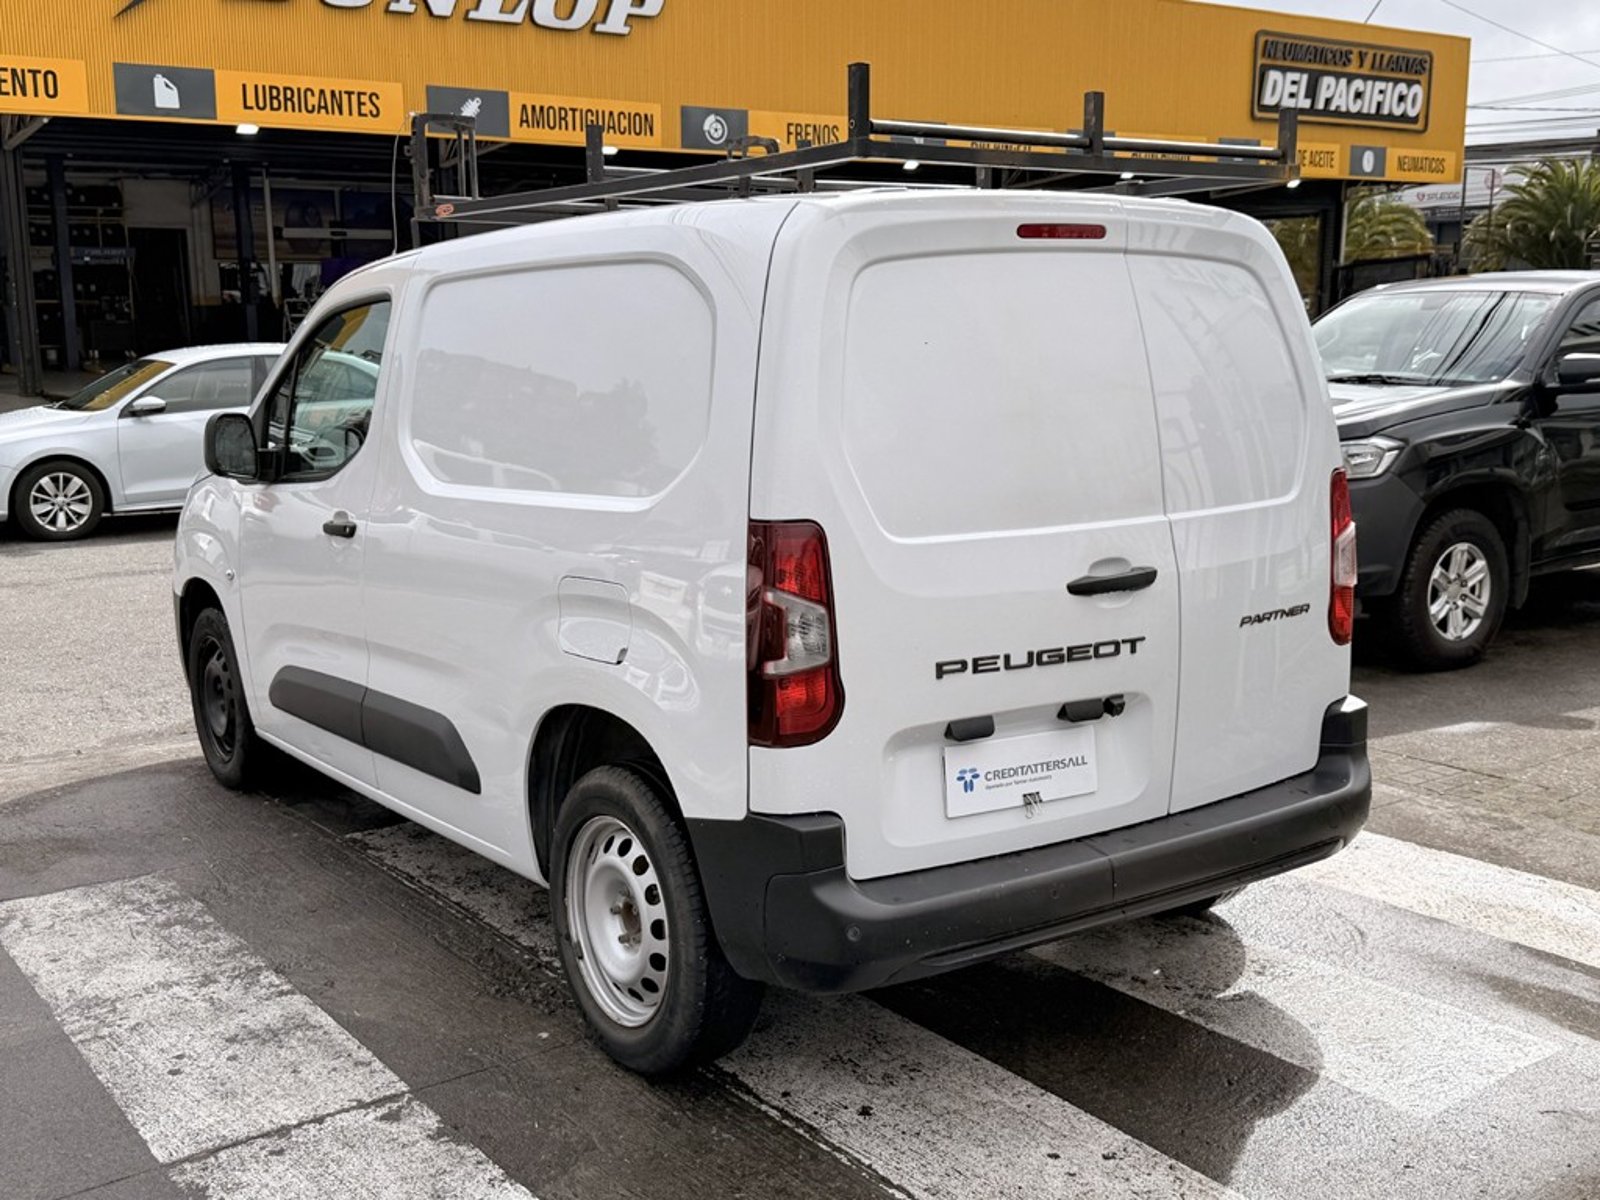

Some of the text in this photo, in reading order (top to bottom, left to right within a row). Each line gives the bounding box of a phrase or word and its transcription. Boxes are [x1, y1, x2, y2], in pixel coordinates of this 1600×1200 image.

[1263, 39, 1428, 75] NEUMATICOS Y LLANTAS
[242, 83, 380, 118] LUBRICANTES
[1261, 69, 1423, 118] DEL PACIFICO
[519, 104, 654, 137] AMORTIGUACION
[786, 122, 839, 145] FRENOS
[1308, 149, 1335, 169] ACEITE
[1397, 155, 1446, 174] NEUMATICOS
[1239, 603, 1310, 628] PARTNER
[935, 636, 1146, 680] PEUGEOT
[984, 755, 1088, 782] CREDITATTERSALL
